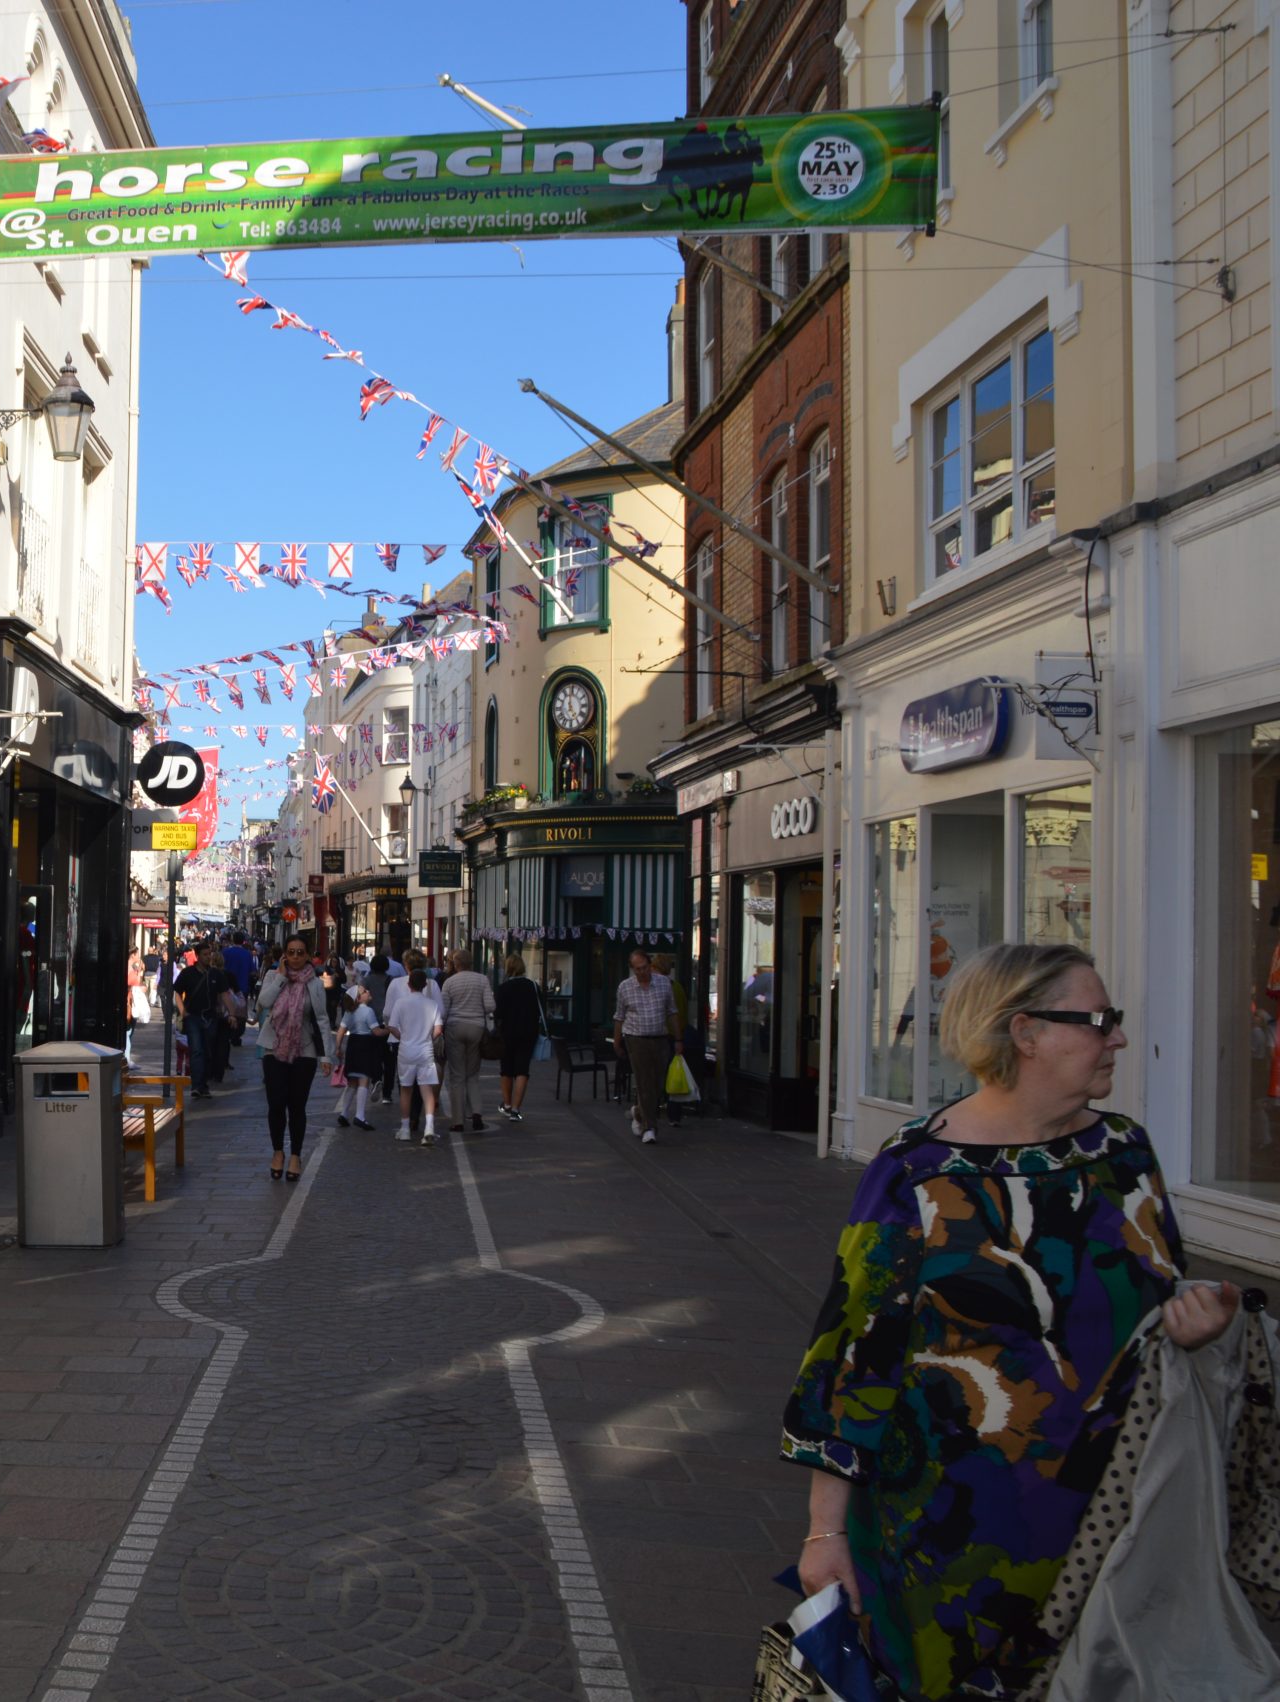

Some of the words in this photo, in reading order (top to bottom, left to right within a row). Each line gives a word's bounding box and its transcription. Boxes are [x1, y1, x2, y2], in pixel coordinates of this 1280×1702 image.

[814, 141, 851, 159] 25th
[34, 157, 310, 203] horse
[340, 132, 664, 185] racing
[801, 161, 860, 176] MAY
[67, 207, 112, 222] Great
[118, 203, 159, 218] Food
[163, 203, 175, 214] &
[181, 199, 226, 214] Drink
[240, 195, 296, 213] Family
[302, 193, 333, 208] Fun
[347, 195, 357, 206] a
[362, 187, 440, 206] Fabulous
[446, 186, 479, 204] Day
[484, 185, 500, 200] at
[507, 183, 536, 198] the
[541, 182, 590, 197] Races
[812, 183, 849, 195] 2.30
[0, 207, 47, 239] @
[26, 228, 74, 250] St.
[85, 223, 198, 247] Ouen
[240, 221, 271, 239] Tel:
[275, 217, 342, 237] 863484
[373, 206, 588, 234] www.jerseyracing.co.uk
[908, 704, 984, 742] Healthspan
[147, 755, 198, 789] JD
[546, 827, 592, 841] RIVOLI
[771, 796, 814, 840] ecco
[44, 1102, 78, 1113] Litter
